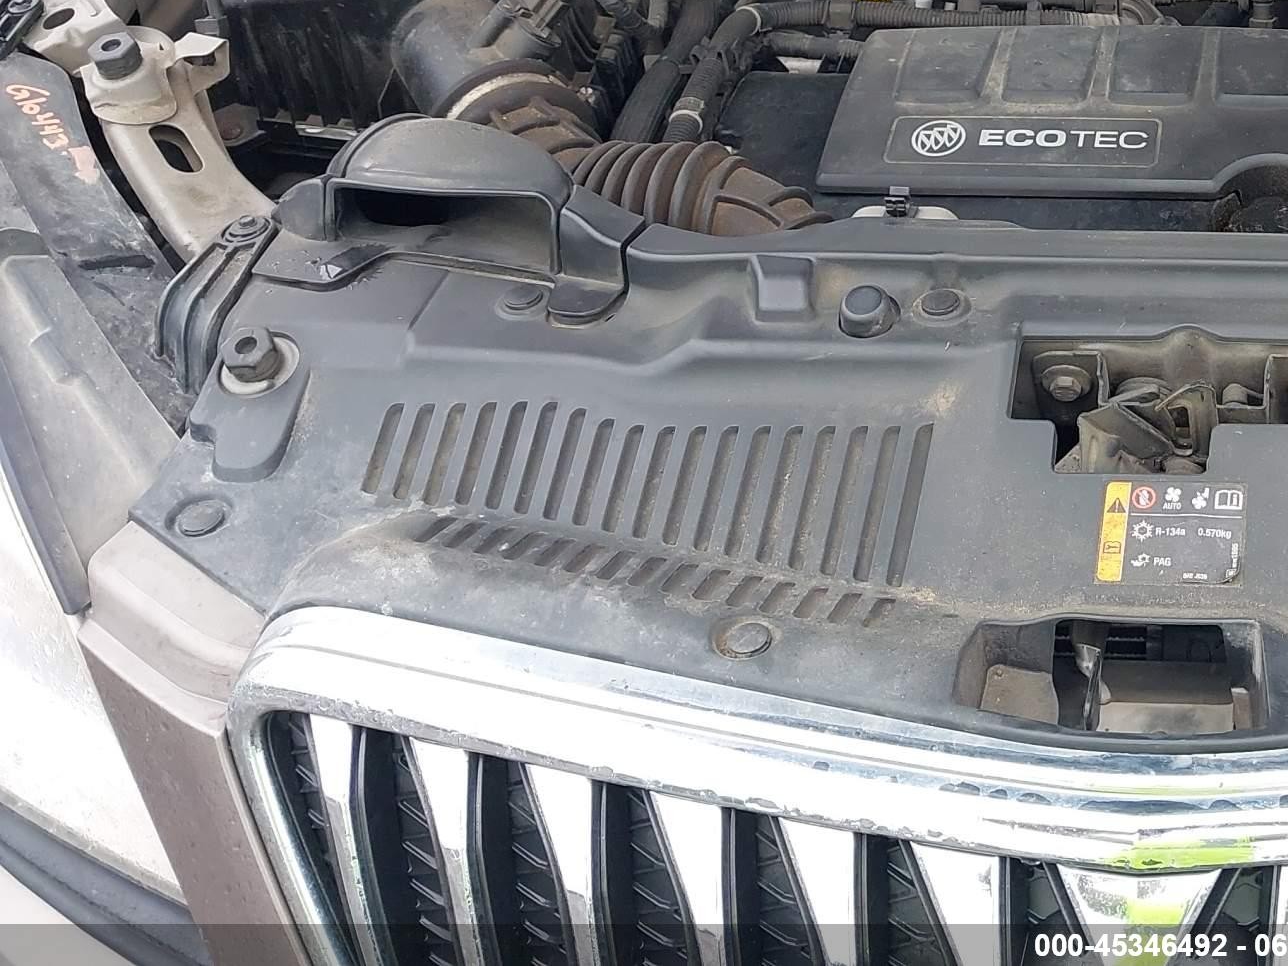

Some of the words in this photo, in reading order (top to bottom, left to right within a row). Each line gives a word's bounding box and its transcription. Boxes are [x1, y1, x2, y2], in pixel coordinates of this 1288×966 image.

[978, 129, 1149, 149] ECOTEC
[1162, 502, 1182, 510] AUTO
[1155, 527, 1186, 536] R-134a
[1197, 527, 1232, 540] 0.570kg
[1153, 557, 1172, 567] PAG
